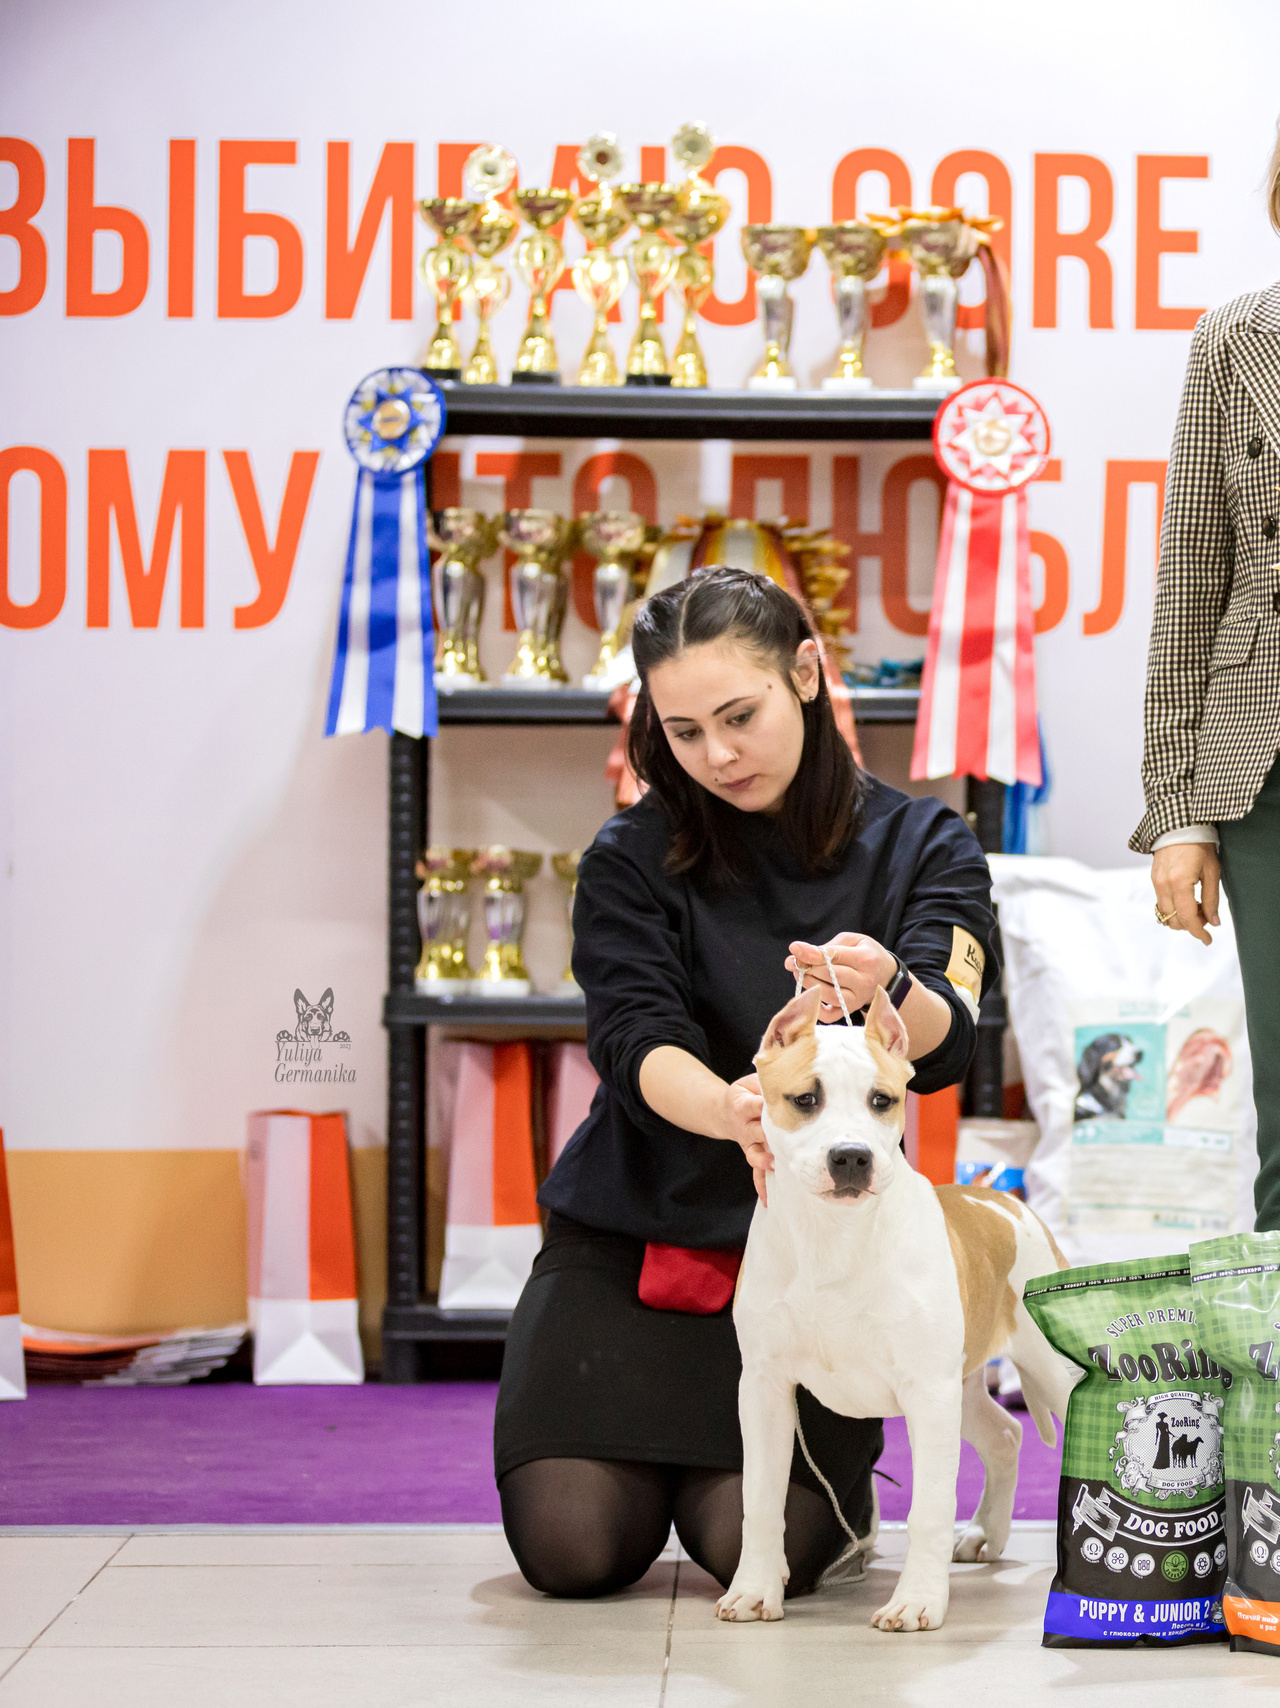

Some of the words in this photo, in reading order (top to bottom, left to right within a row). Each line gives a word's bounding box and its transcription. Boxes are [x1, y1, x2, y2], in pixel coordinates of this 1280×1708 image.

[1105, 1312, 1145, 1338] SUPER
[1154, 1393, 1169, 1401] HIGH
[1176, 1480, 1194, 1488] FOOD
[1123, 1512, 1169, 1538] DOG
[1173, 1510, 1219, 1538] FOOD
[1079, 1599, 1128, 1622] PUPPY
[1133, 1603, 1145, 1623] &
[1150, 1601, 1201, 1623] JUNIOR
[1203, 1599, 1211, 1619] 2
[1264, 1624, 1277, 1632] рис
